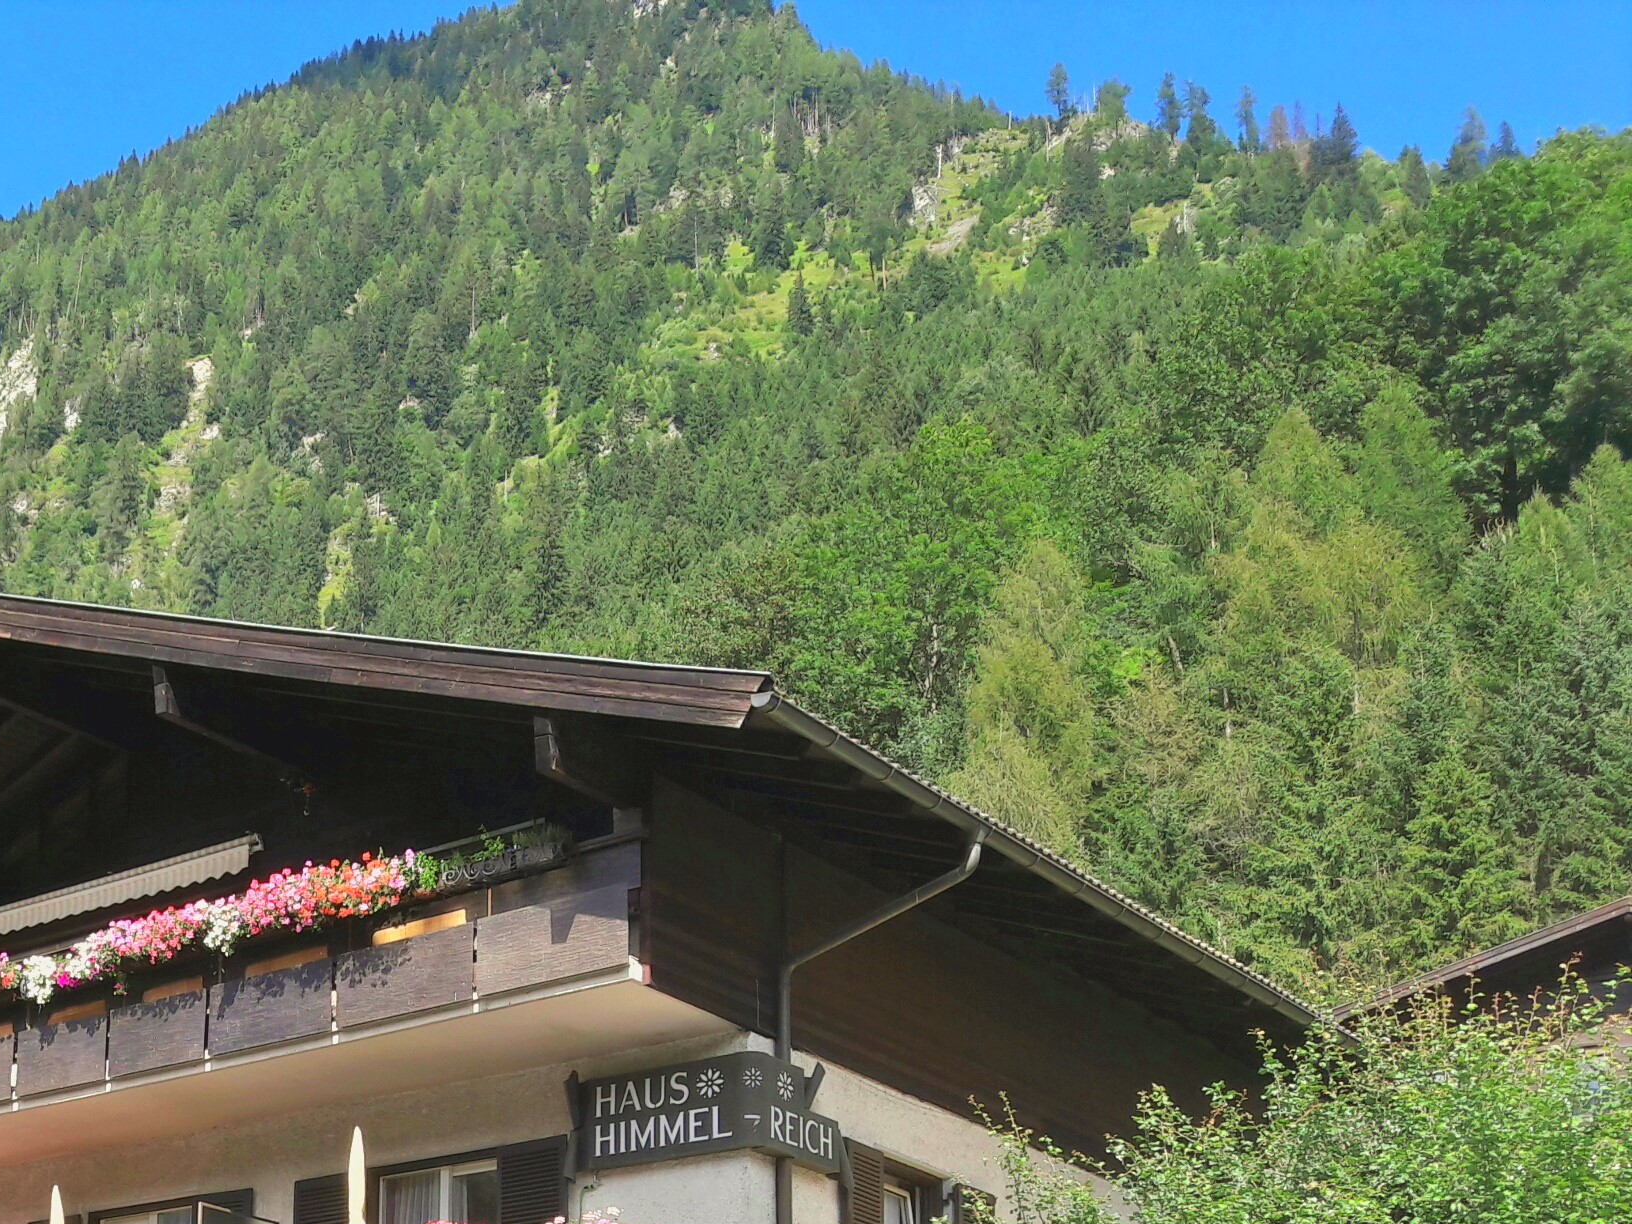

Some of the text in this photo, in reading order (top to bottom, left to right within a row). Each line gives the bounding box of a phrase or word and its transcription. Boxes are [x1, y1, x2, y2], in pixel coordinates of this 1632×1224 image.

[594, 1071, 690, 1118] HAUS
[594, 1105, 733, 1157] HIMMEL
[770, 1105, 833, 1160] REICH
